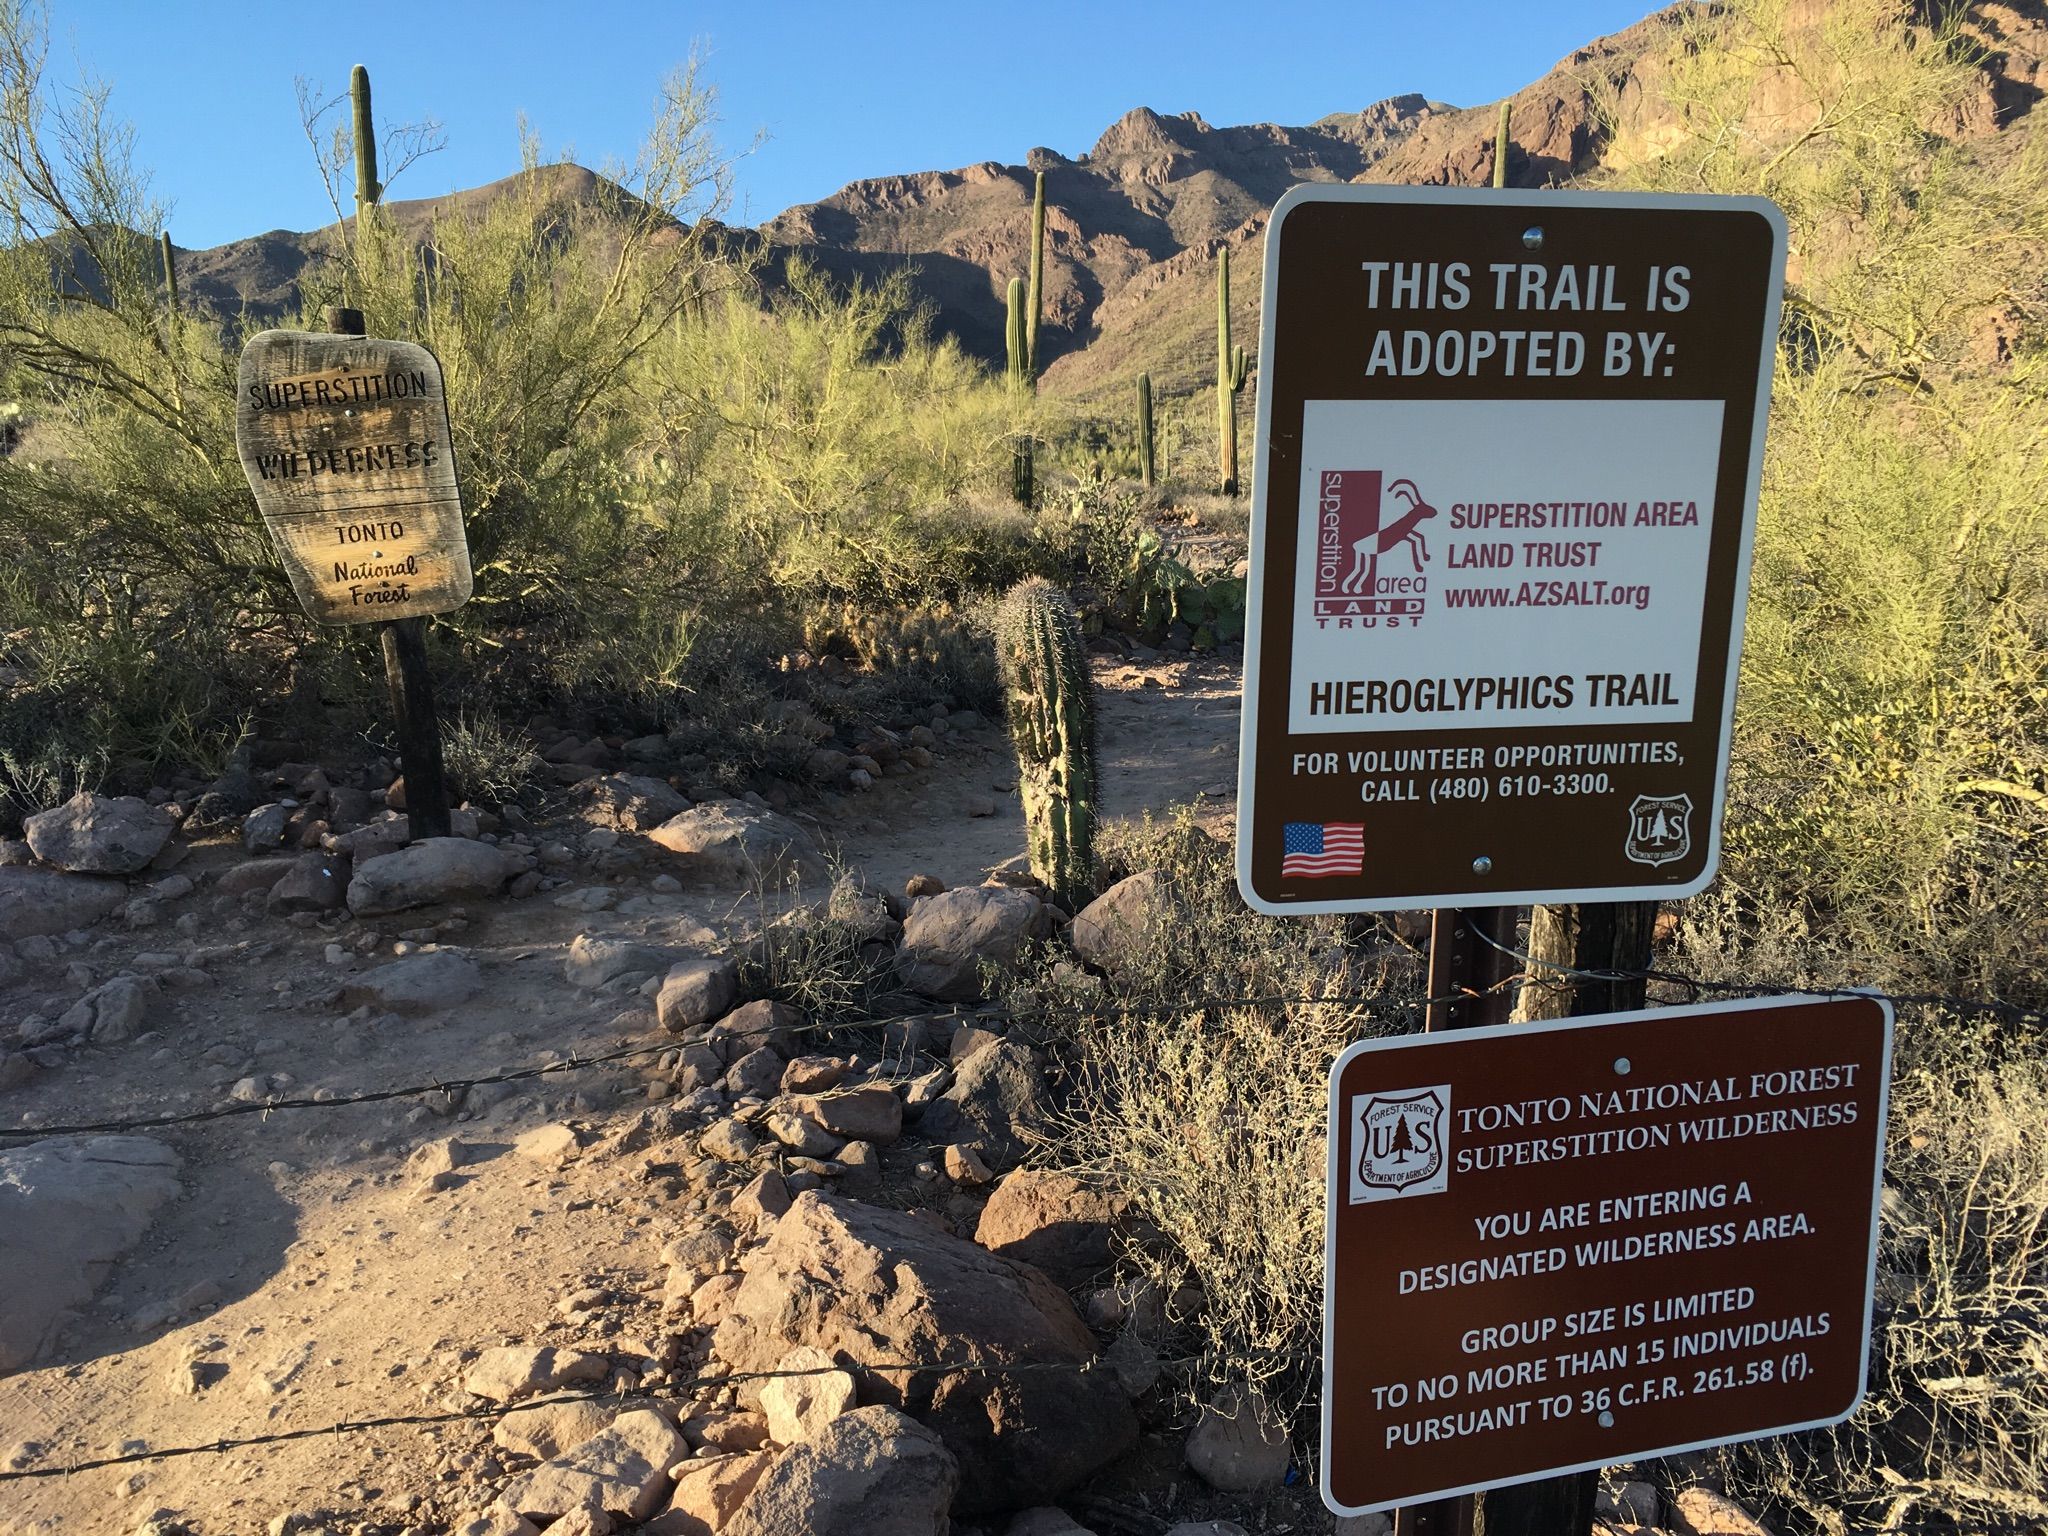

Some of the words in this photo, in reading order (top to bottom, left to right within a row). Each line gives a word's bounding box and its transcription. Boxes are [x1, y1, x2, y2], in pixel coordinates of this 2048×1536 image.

[1362, 262, 1471, 310] THIS
[1490, 263, 1626, 311] TRAIL
[1647, 266, 1691, 312] IS
[1365, 330, 1585, 377] ADOPTED
[1603, 332, 1675, 377] BY:
[250, 371, 427, 410] SUPERSTITION
[256, 441, 438, 480] WILDERNESS
[1450, 503, 1627, 529] SUPERSTITION
[1633, 502, 1698, 527] AREA
[335, 522, 403, 544] TONTO
[1320, 473, 1342, 593] superstition
[334, 556, 417, 583] National
[1448, 543, 1513, 568] LAND
[1523, 542, 1601, 567] TRUST
[349, 584, 410, 606] Forest
[1376, 577, 1427, 594] area
[1445, 581, 1650, 610] www.AZSALT.org
[1316, 616, 1422, 629] TRUST
[1318, 600, 1422, 614] LAND
[1310, 675, 1573, 715] HIEROGLYPHICS
[1586, 673, 1679, 707] TRAIL
[1293, 753, 1338, 775] FOR
[1348, 747, 1484, 773] VOLUNTEER
[1494, 742, 1684, 768] OPPORTUNITIES,
[1361, 780, 1419, 802] CALL
[1429, 777, 1489, 803] (480)
[1499, 773, 1614, 797] 610-3300.
[1636, 802, 1659, 815] FOREST
[1662, 802, 1686, 813] SERVICE
[1370, 1105, 1400, 1125] FOREST
[1403, 1104, 1435, 1117] SERVICE
[1458, 1097, 1571, 1134] TONTO
[1579, 1078, 1740, 1120] NATIONAL
[1749, 1064, 1859, 1097] FOREST
[1456, 1123, 1671, 1173] SUPERSTITION
[1678, 1102, 1858, 1145] WILDERNESS
[1364, 1160, 1395, 1182] DEPARTMENT
[1397, 1173, 1404, 1181] OF
[1406, 1152, 1437, 1180] AGRICULTURE
[1474, 1212, 1531, 1241] YOU
[1538, 1205, 1590, 1232] ARE
[1599, 1185, 1726, 1224] ENTERING
[1733, 1182, 1752, 1203] A
[1399, 1247, 1567, 1295] DESIGNATED
[1574, 1223, 1736, 1267] WILDERNESS
[1743, 1213, 1816, 1243] AREA.
[1461, 1318, 1556, 1354] GROUP
[1564, 1304, 1615, 1335] SIZE
[1624, 1303, 1646, 1327] IS
[1654, 1287, 1754, 1323] LIMITED
[1372, 1384, 1408, 1411] TO
[1417, 1376, 1459, 1402] NO
[1468, 1363, 1548, 1394] MORE
[1555, 1345, 1627, 1378] THAN
[1636, 1341, 1665, 1364] 15
[1673, 1312, 1830, 1359] INDIVIDUALS
[1385, 1401, 1531, 1449] PURSUANT
[1538, 1396, 1572, 1420] TO
[1581, 1387, 1611, 1413] 36
[1618, 1378, 1685, 1408] C.F.R.
[1693, 1361, 1773, 1394] 261.58
[1780, 1353, 1814, 1384] (f).
